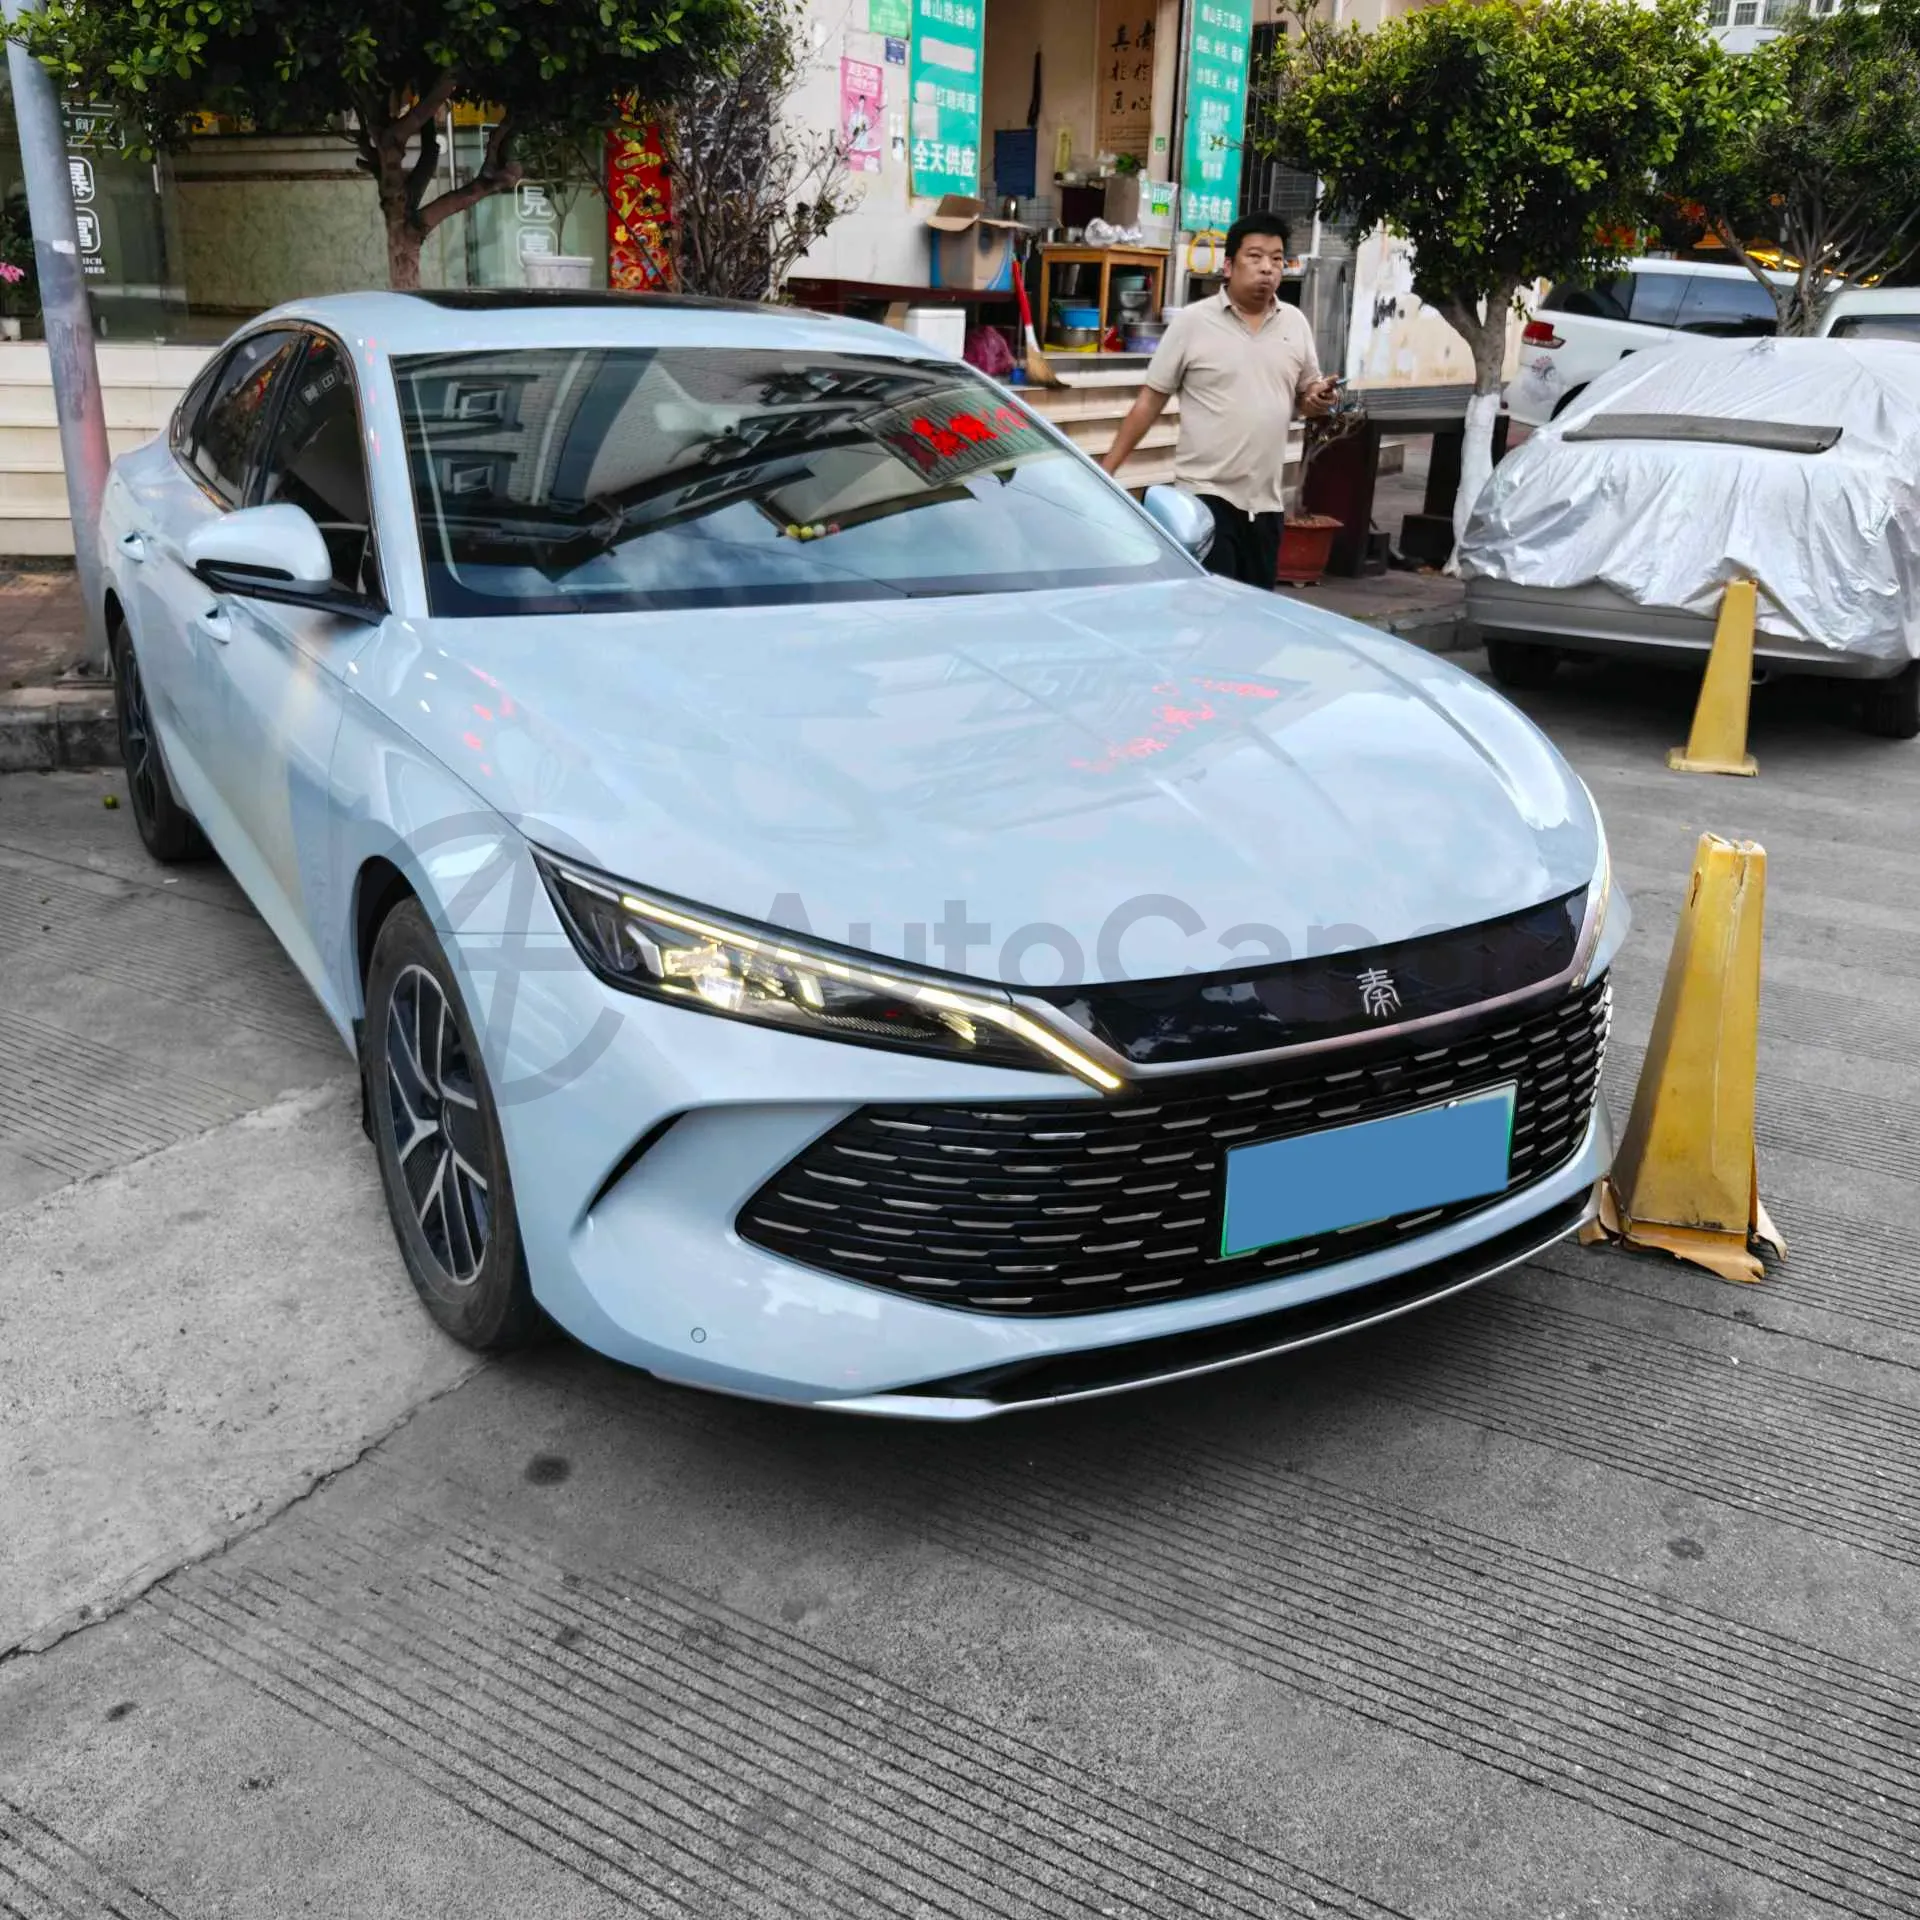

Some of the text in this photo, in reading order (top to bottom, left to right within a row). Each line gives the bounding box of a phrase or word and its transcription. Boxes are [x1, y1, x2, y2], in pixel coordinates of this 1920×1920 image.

[913, 140, 976, 177] 全天供应
[1188, 192, 1232, 224] 全天供应
